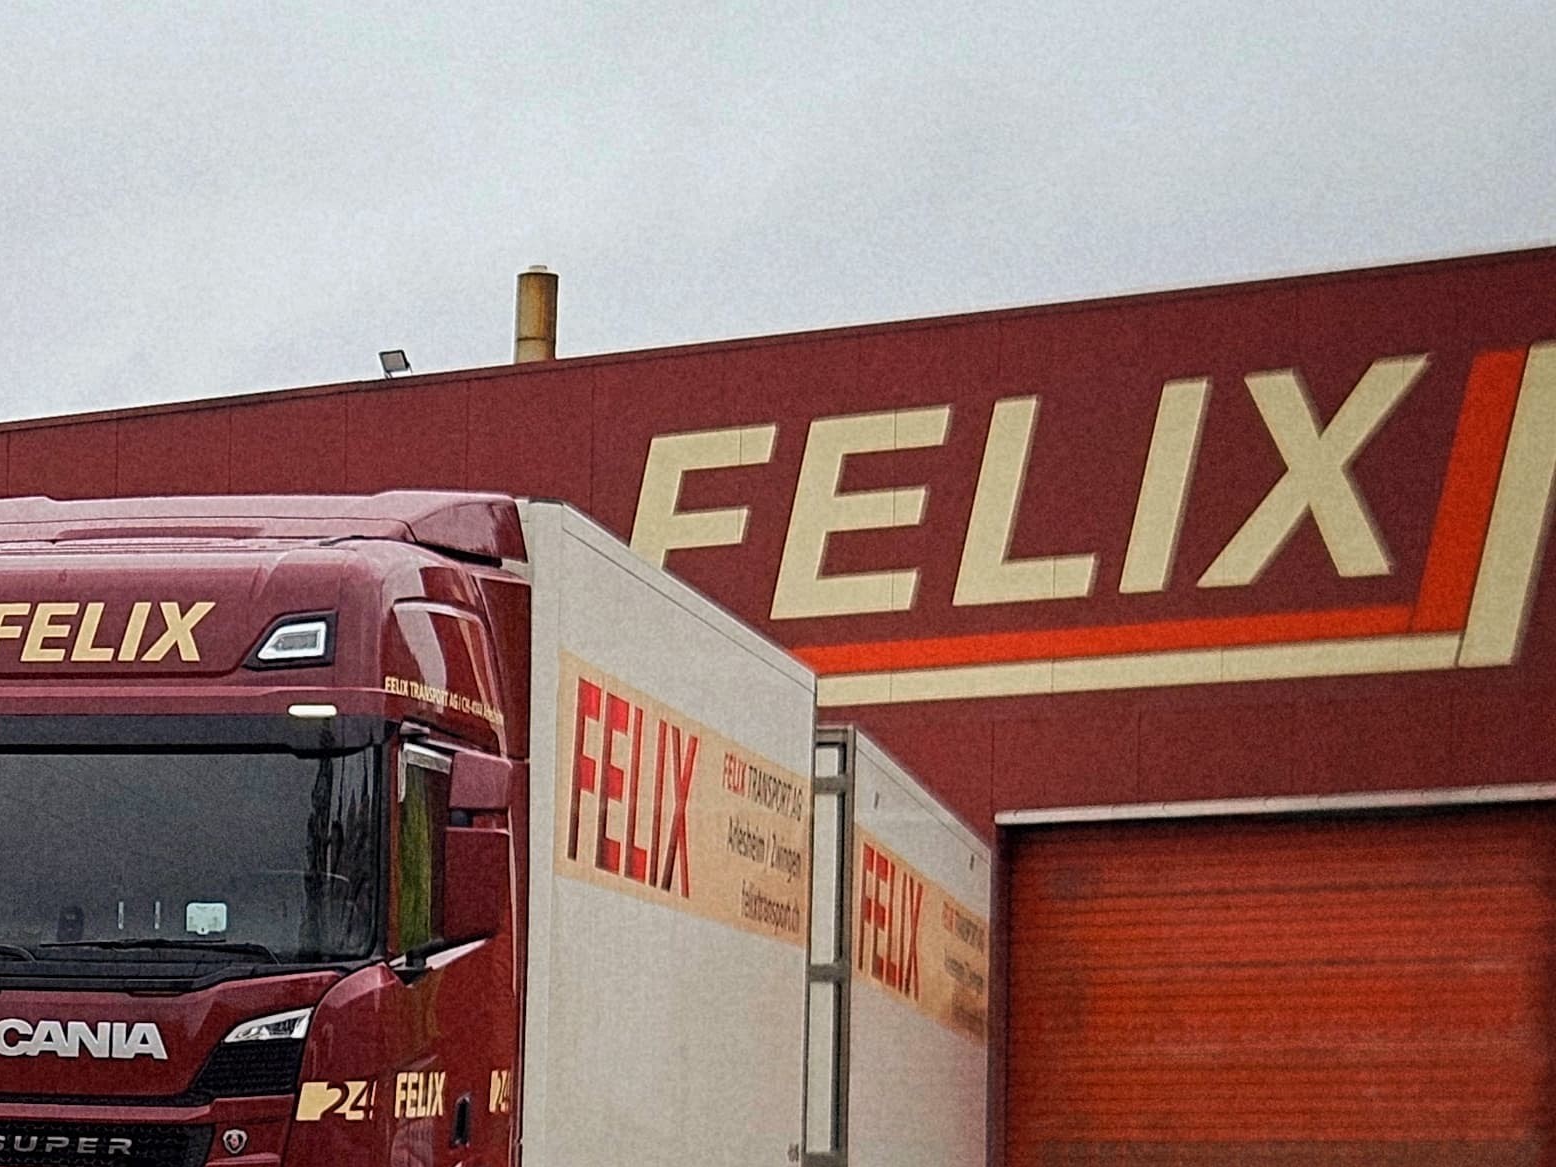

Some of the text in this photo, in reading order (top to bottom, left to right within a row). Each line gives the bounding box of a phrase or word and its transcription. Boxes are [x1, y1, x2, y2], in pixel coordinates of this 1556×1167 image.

[629, 352, 1433, 620] FELIX
[384, 676, 409, 696] FELIX
[410, 681, 448, 707] TRANSPORT
[567, 676, 699, 900] FELIX
[723, 752, 803, 822] FELIX TRANSPORT AG
[727, 814, 765, 864] Arlesheim
[858, 842, 924, 1002] FELIX
[394, 1071, 446, 1119] FELIX
